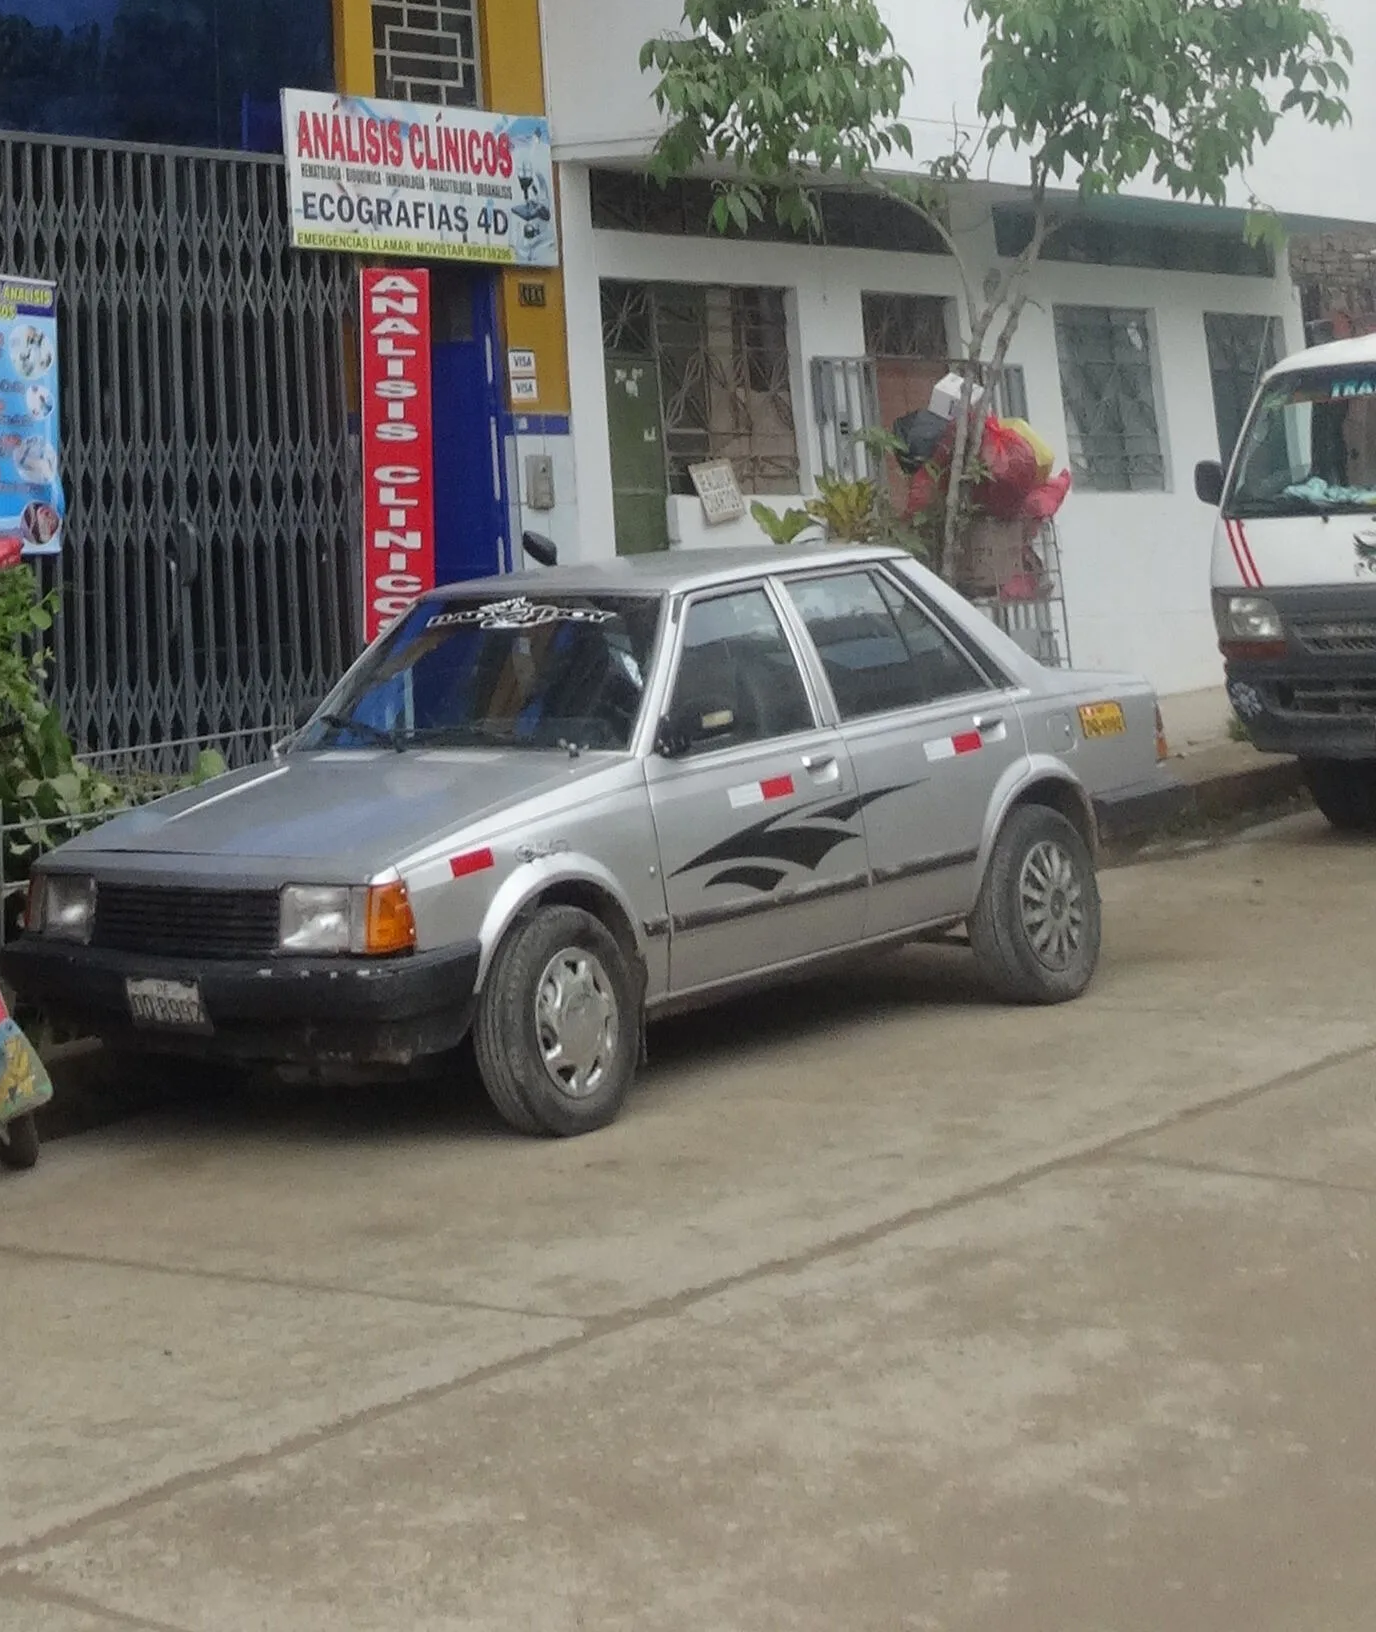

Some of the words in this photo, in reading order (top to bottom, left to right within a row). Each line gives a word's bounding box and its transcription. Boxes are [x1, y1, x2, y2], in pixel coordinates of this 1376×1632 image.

[297, 100, 403, 169] ANÁLISIS
[409, 112, 513, 179] CLÍNICOS
[302, 191, 469, 233] ECOGRAFIAS
[477, 205, 509, 235] 4D
[297, 232, 369, 249] EMERGENCIAS
[416, 240, 465, 257] MOVISTAR
[370, 275, 421, 442] ANALISIS
[513, 356, 532, 368] VISA
[515, 383, 534, 394] VISA
